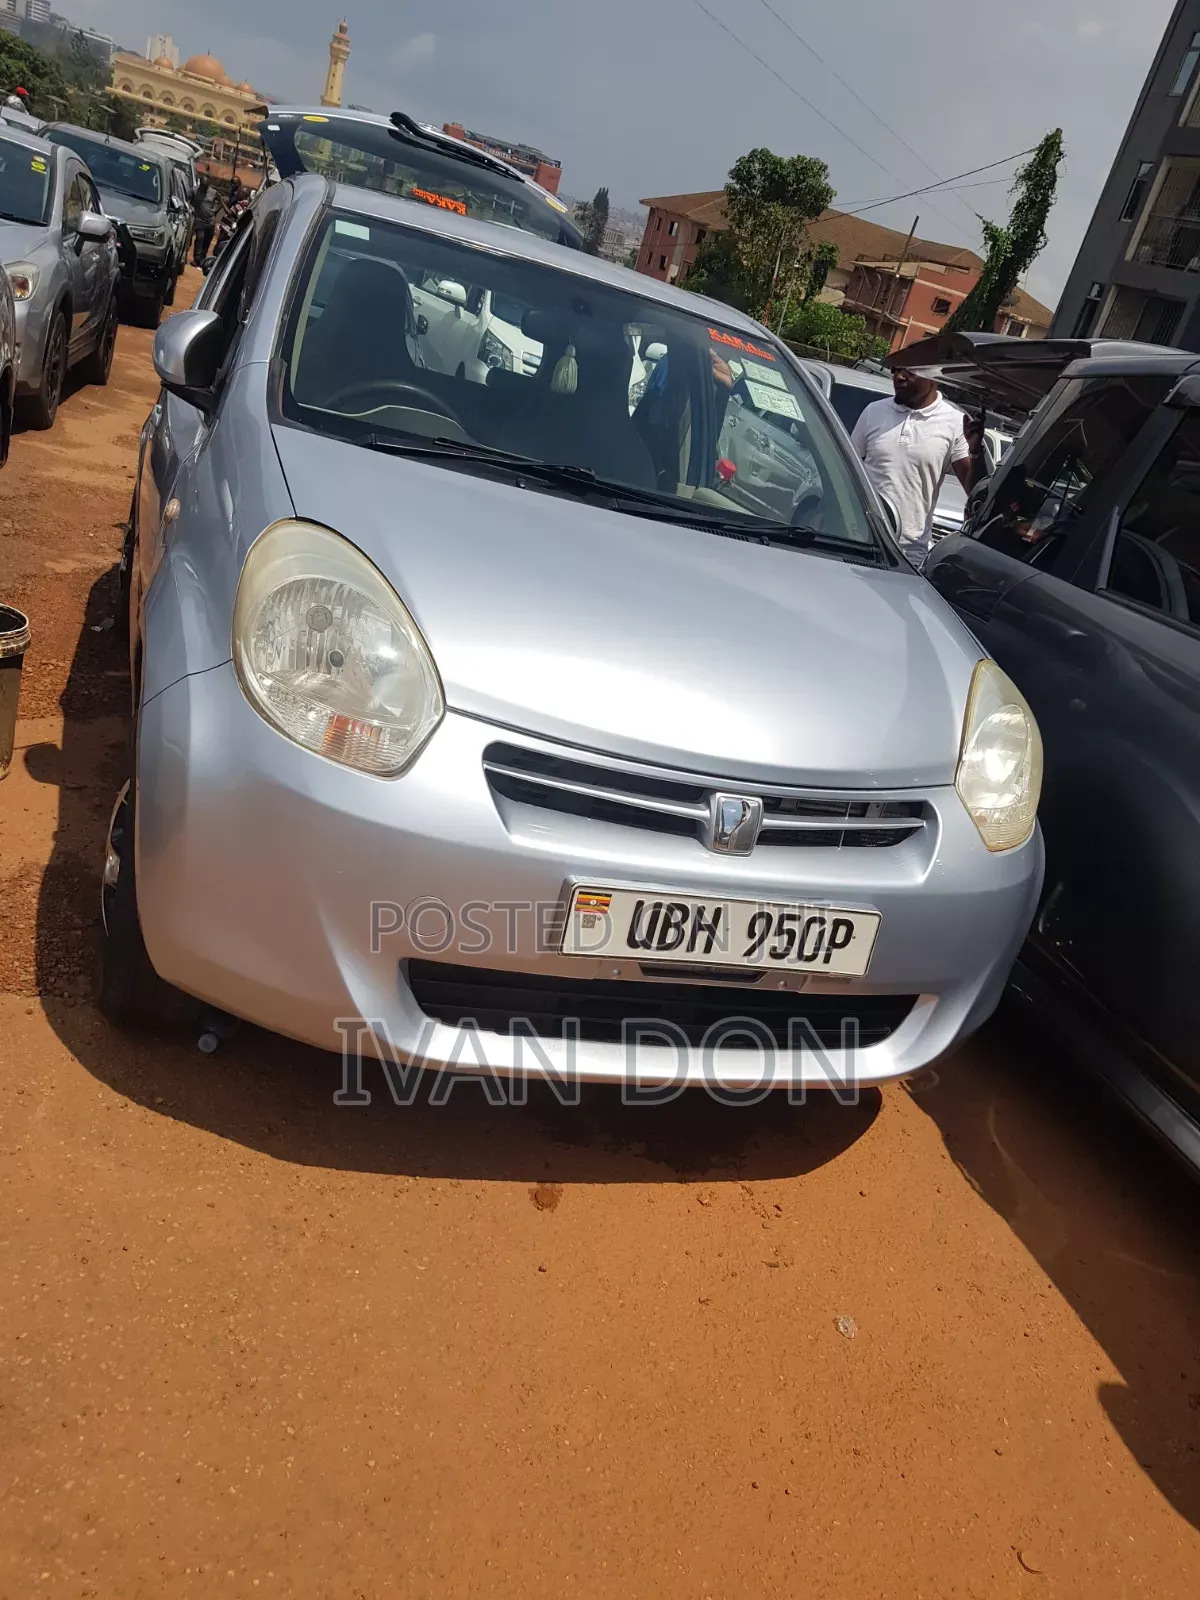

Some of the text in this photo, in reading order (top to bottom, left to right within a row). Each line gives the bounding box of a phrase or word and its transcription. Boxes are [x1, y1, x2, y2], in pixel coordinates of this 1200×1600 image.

[427, 194, 467, 216] KAKA
[627, 900, 855, 964] UBH 950P
